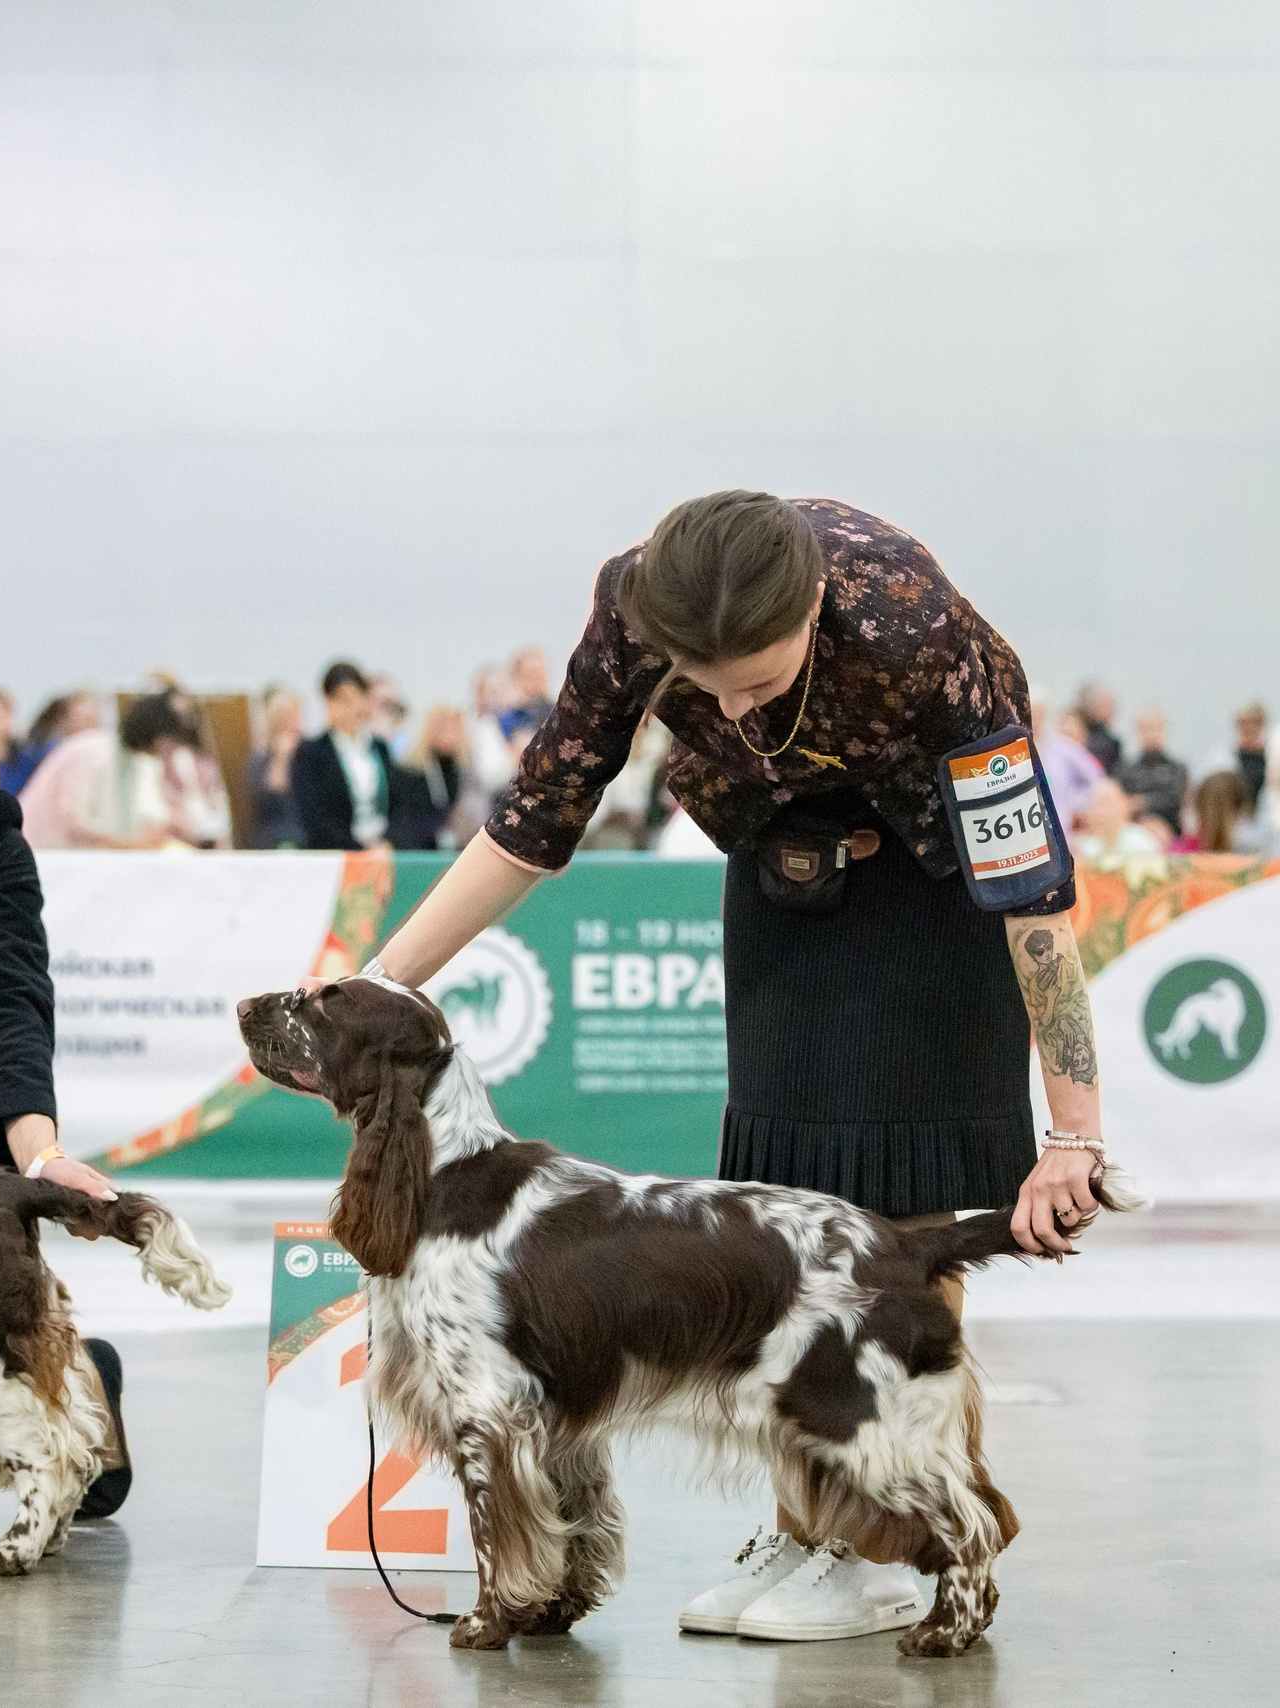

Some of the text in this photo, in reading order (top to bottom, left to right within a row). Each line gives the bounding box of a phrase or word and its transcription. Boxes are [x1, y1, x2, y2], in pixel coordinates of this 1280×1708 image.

[986, 773, 1017, 788] ЕВРАЗИЯ
[973, 802, 1043, 844] 3616
[996, 850, 1038, 868] 19.11.2023
[326, 1342, 448, 1555] 2
